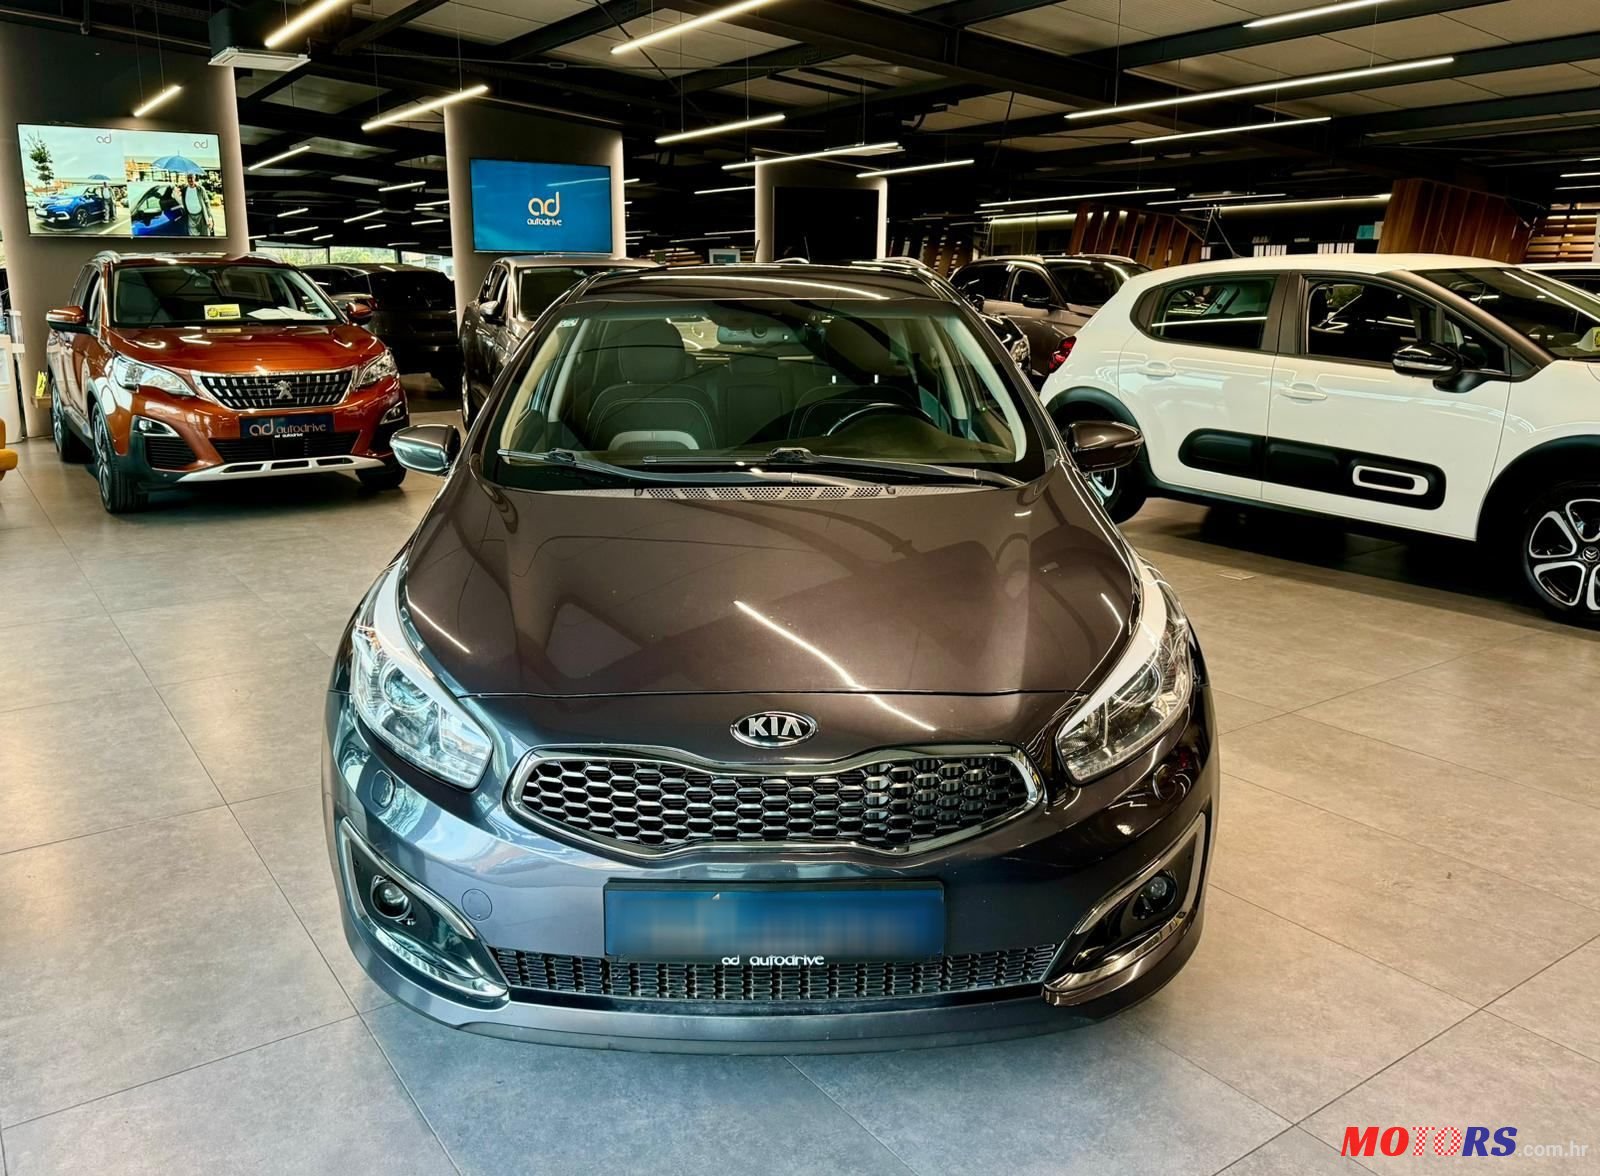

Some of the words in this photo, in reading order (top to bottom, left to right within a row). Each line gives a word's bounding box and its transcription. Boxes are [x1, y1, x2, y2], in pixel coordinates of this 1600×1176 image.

[96, 133, 112, 144] ad
[193, 138, 209, 149] ad
[528, 191, 560, 217] ad
[526, 217, 563, 226] autodrive
[249, 418, 274, 437] ad
[276, 423, 327, 434] autodrive
[747, 716, 803, 737] KIA
[721, 954, 740, 966] ad
[749, 954, 825, 967] autodrive
